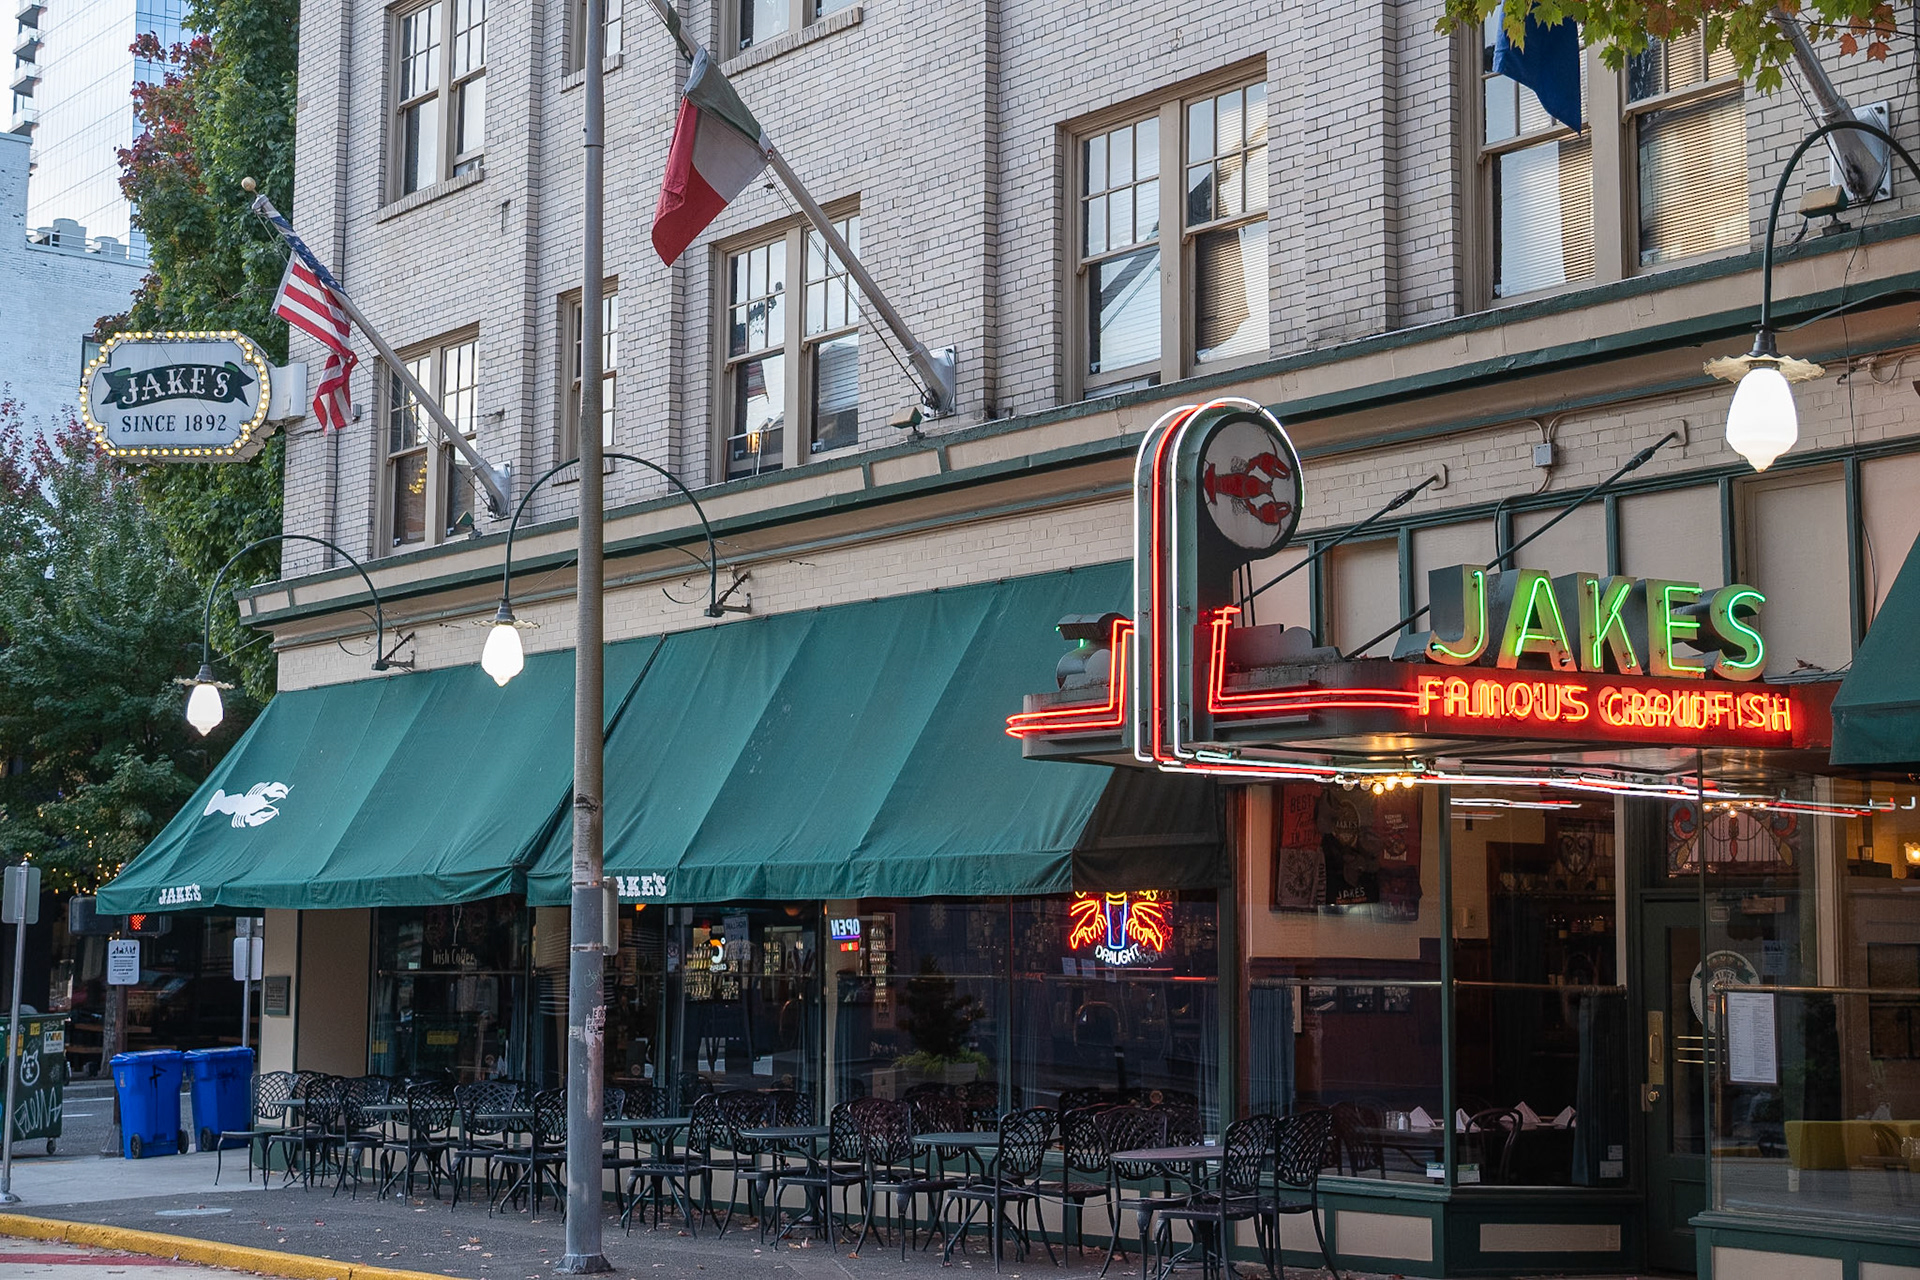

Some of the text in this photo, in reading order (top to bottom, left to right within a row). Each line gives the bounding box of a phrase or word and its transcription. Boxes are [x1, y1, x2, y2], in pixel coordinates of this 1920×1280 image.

[121, 366, 231, 405] JAKE'S
[121, 414, 227, 433] SINCE 1892
[1425, 564, 1768, 682] JAKES
[1417, 674, 1792, 732] FAMOUS CRAWFISH
[158, 882, 202, 905] JAKE'S
[603, 872, 667, 897] AKE'S
[432, 948, 476, 965] Irish Coffee
[1095, 943, 1140, 965] DRAUGHT
